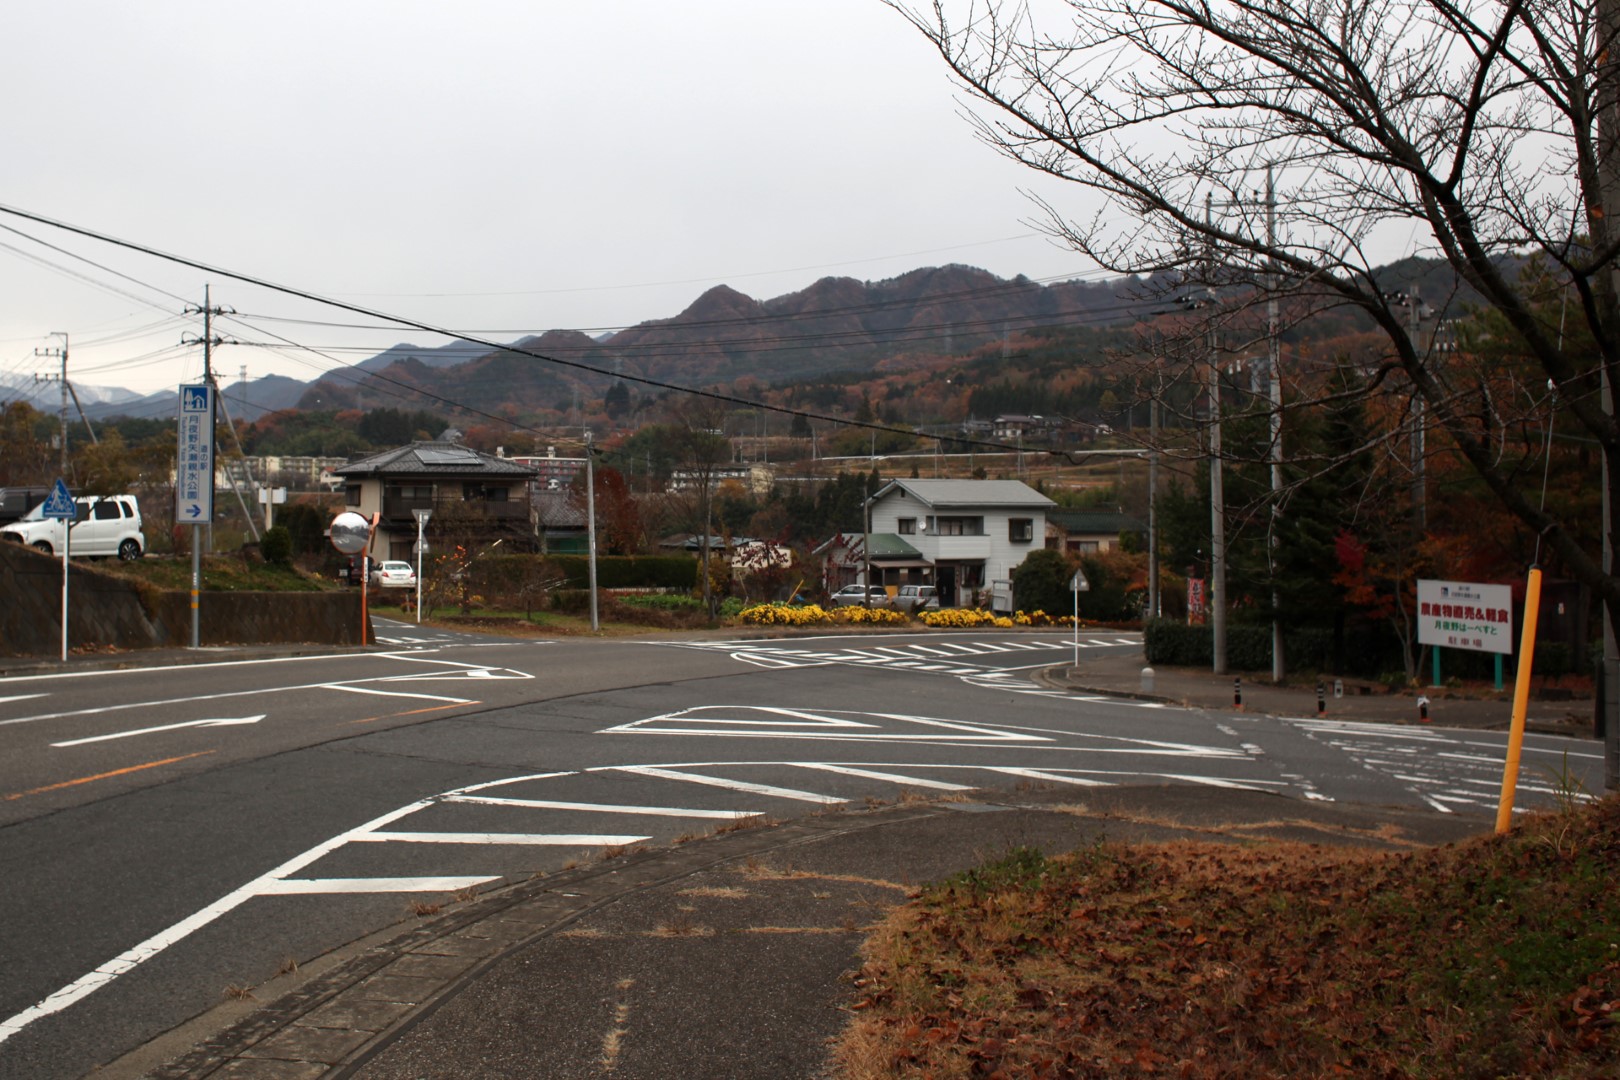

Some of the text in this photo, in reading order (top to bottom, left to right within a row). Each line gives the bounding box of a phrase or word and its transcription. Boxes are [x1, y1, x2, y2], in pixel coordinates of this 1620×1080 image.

[187, 415, 198, 499] 月夜野矢瀬親水公園
